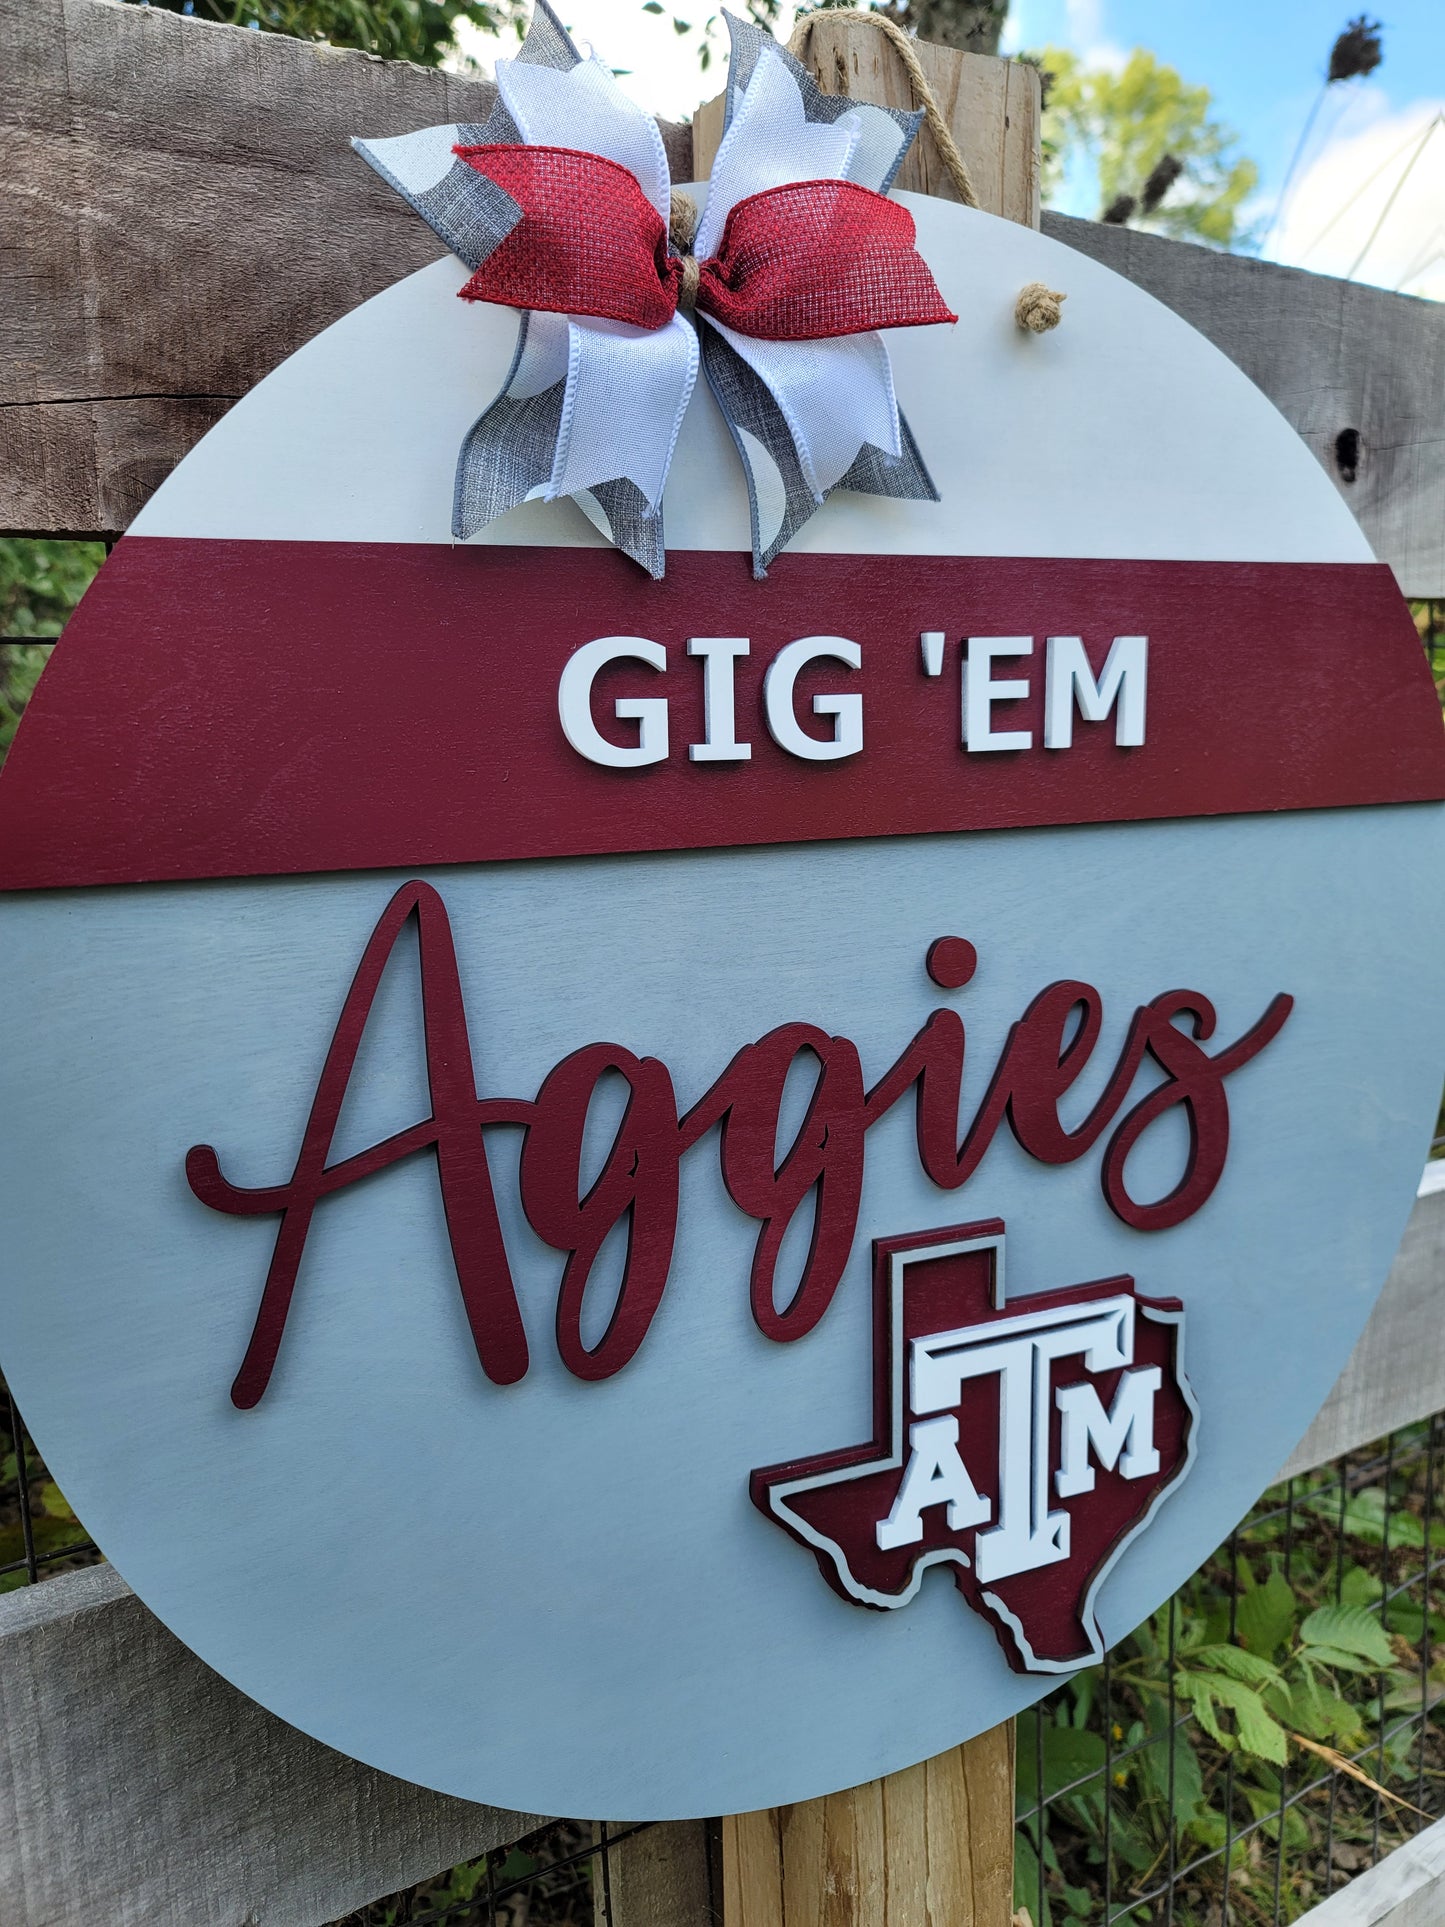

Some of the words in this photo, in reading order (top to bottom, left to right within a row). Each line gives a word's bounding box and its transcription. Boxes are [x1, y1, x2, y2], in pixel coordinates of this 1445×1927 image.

[558, 636, 863, 767] GIG
[920, 632, 1148, 752] 'EM
[186, 879, 1293, 1409] Aggies
